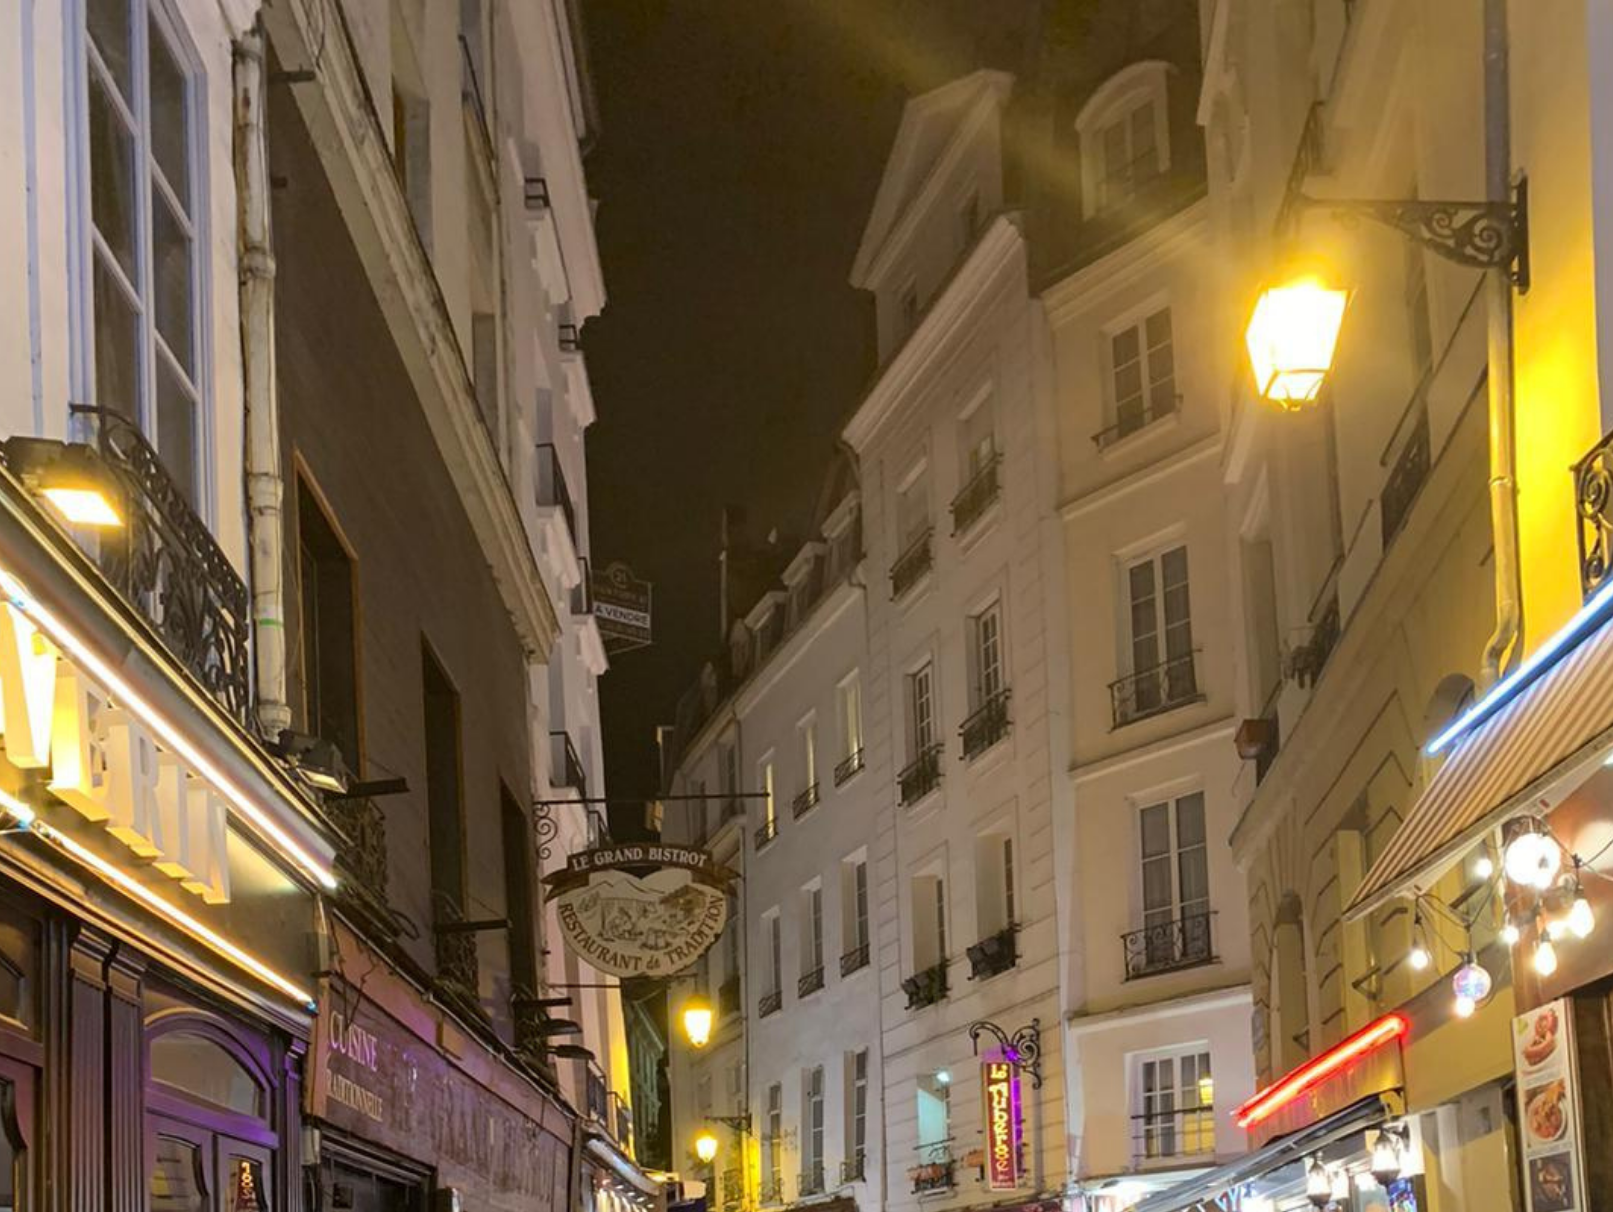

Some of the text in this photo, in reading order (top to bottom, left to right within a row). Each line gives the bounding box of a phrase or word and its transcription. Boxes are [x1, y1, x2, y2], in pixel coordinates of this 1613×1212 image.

[605, 606, 648, 625] VENDRE
[572, 846, 708, 871] LE GRAND BISTROT
[558, 903, 642, 971] RESTAURANT
[665, 895, 724, 966] TRADITION
[330, 1010, 377, 1073] CUISINE
